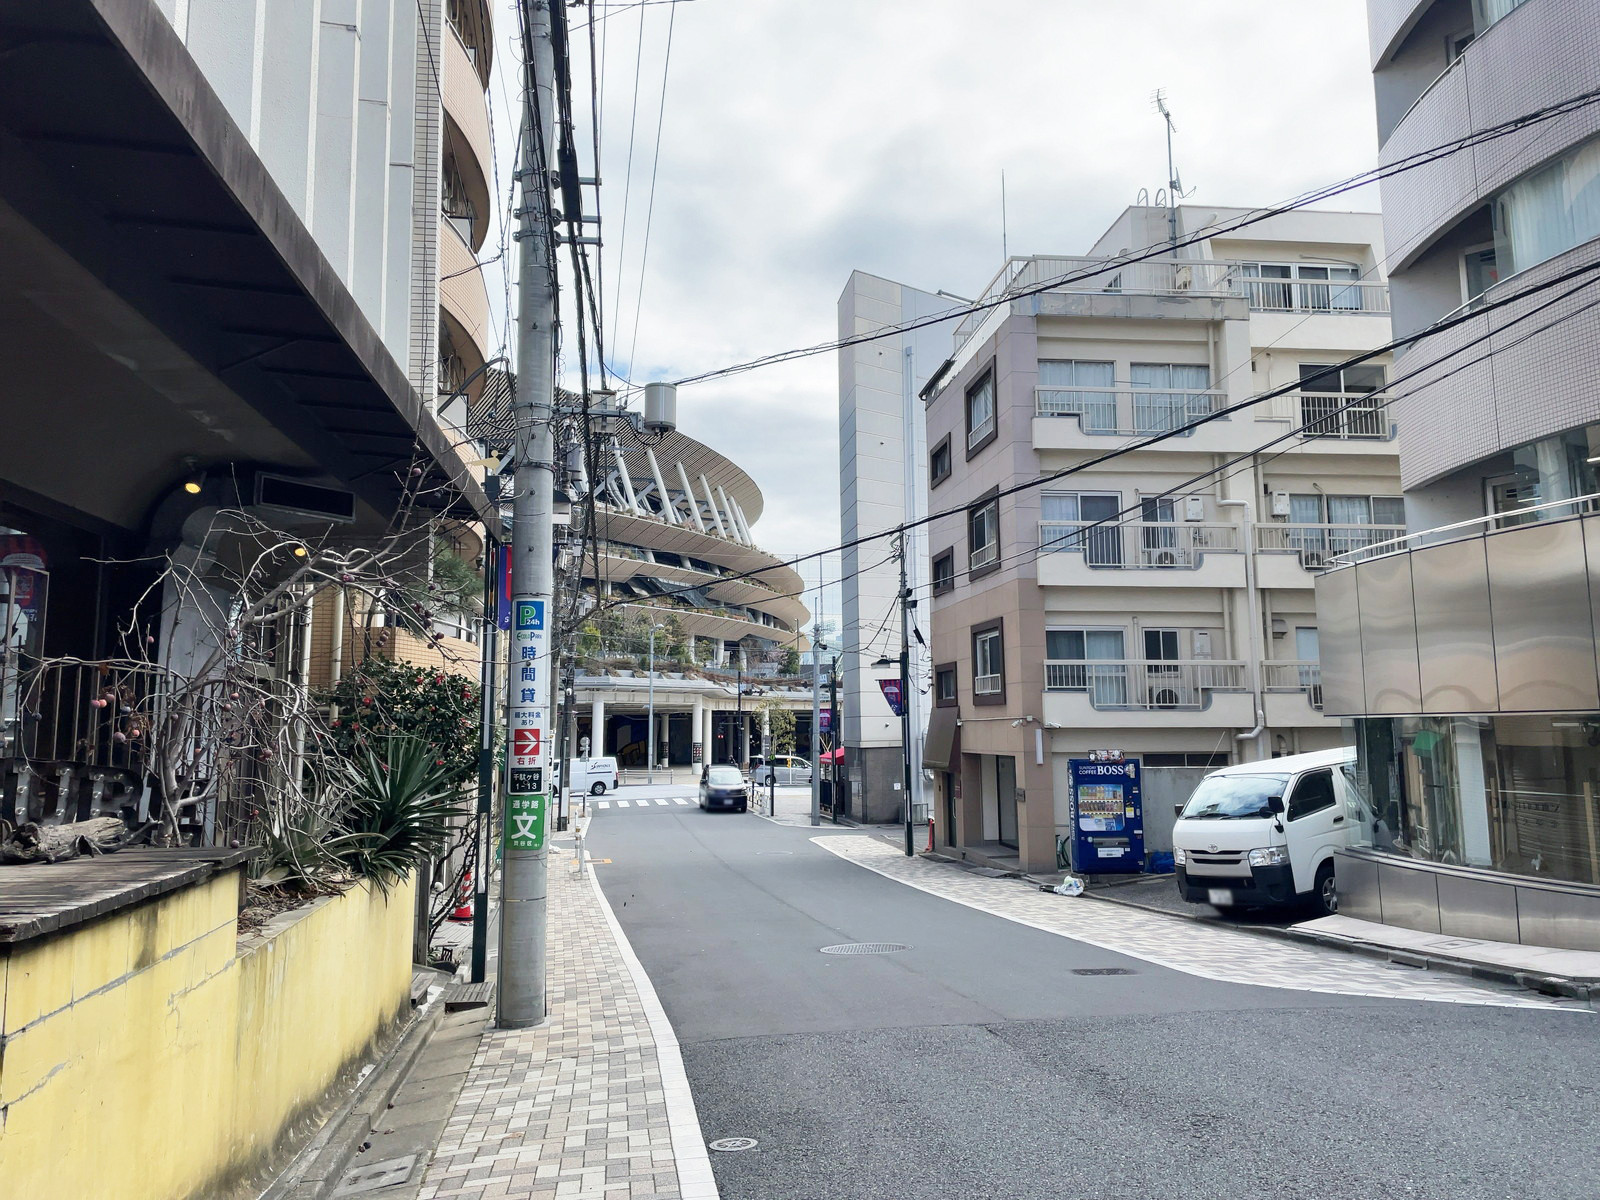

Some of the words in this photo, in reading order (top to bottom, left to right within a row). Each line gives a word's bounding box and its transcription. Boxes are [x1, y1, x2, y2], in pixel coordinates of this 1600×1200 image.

[519, 605, 537, 626] P
[526, 618, 540, 626] 24h
[520, 646, 537, 703] 時間貸
[514, 711, 542, 719] 最大料金
[516, 757, 537, 766] 右折
[1096, 765, 1124, 776] BOSS
[515, 782, 537, 790] 1-13
[512, 799, 539, 809] 通学路
